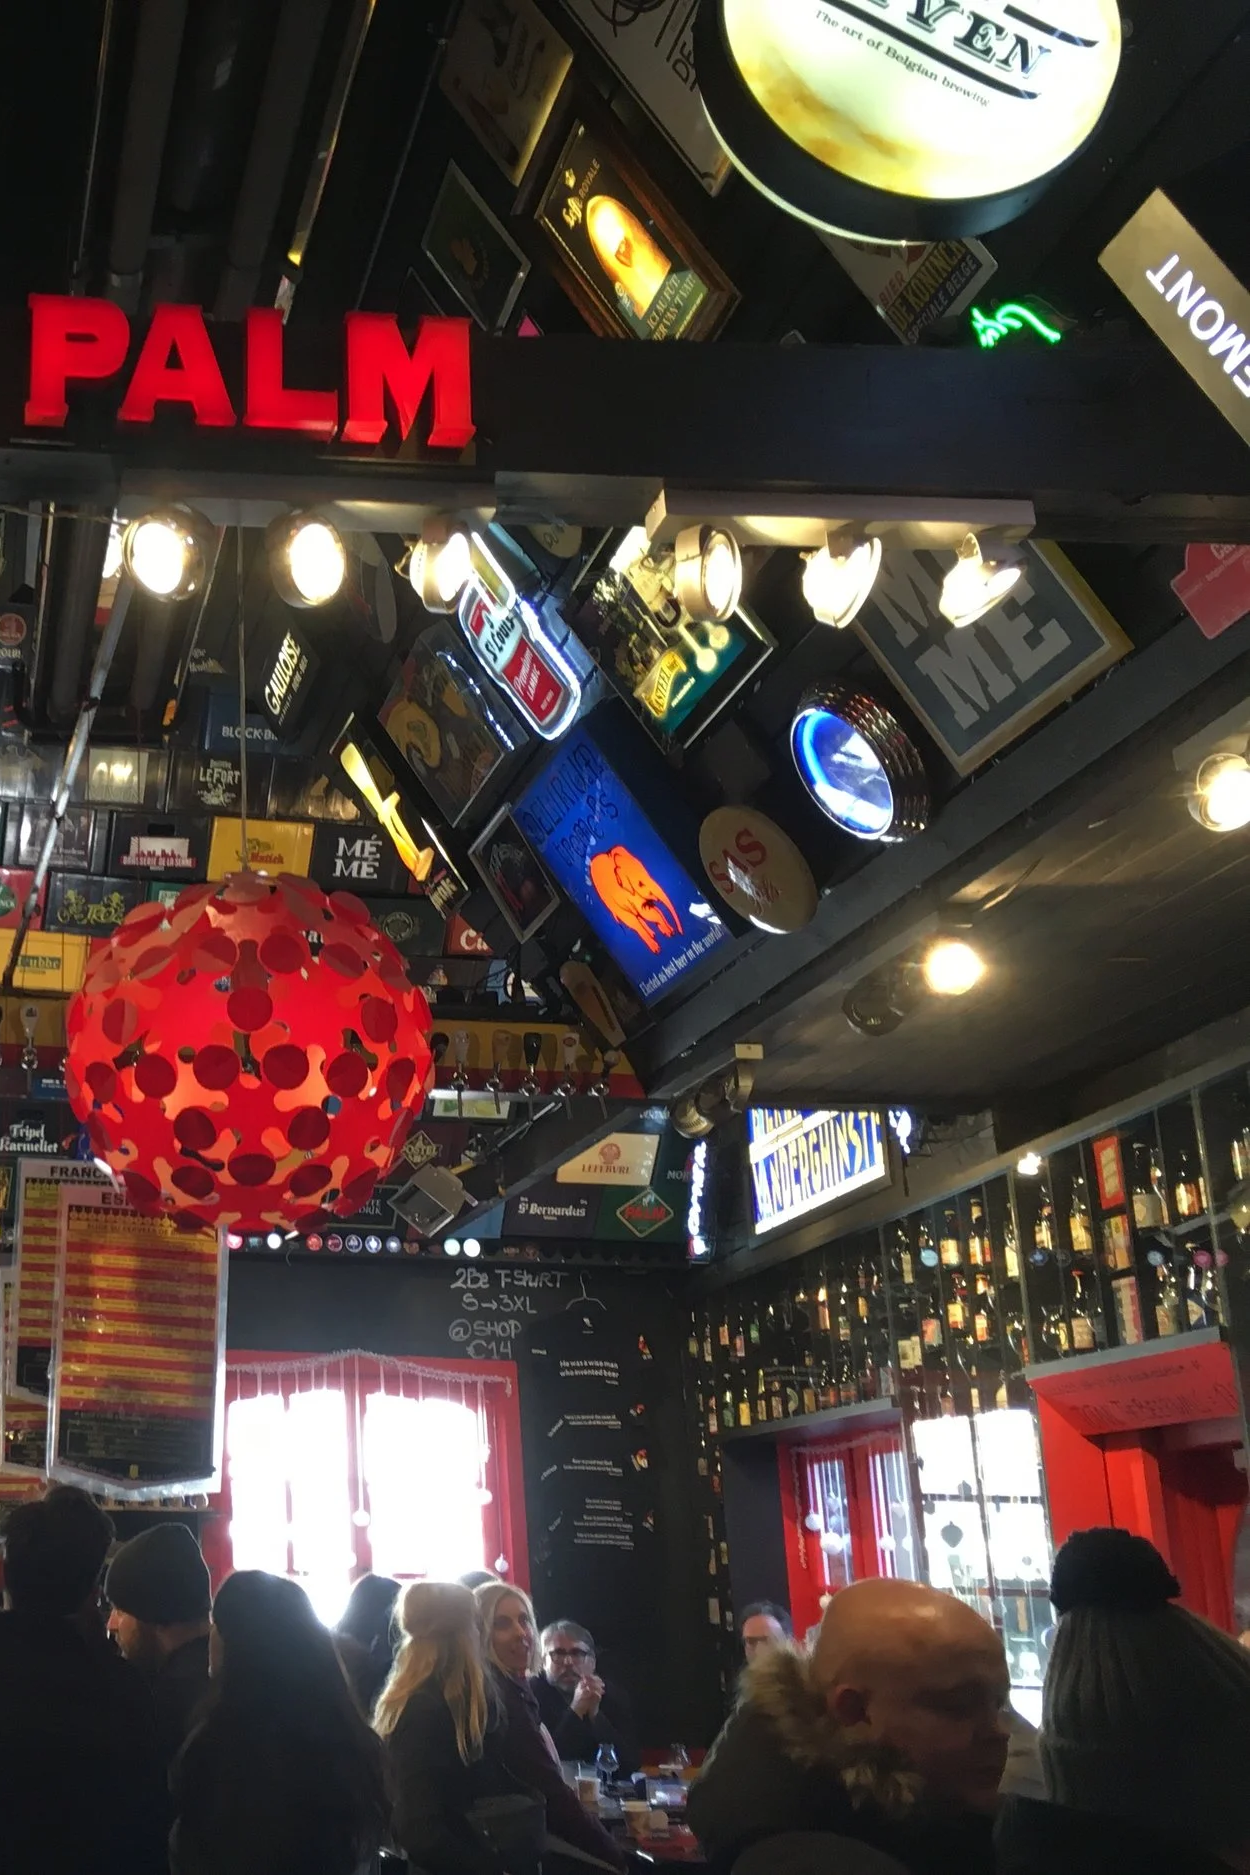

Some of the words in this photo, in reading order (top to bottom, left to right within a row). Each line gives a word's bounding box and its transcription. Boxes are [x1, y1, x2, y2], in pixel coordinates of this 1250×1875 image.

[815, 9, 839, 28] The
[842, 24, 863, 41] art
[866, 37, 883, 50] of
[885, 45, 938, 81] Belgian
[878, 270, 906, 306] BIER
[906, 290, 949, 344] SPECIALE
[945, 253, 979, 297] BELGE
[23, 293, 475, 448] PALM
[264, 629, 301, 716] GAULOISE
[639, 972, 661, 997] Elected
[9, 1121, 46, 1140] Tripel
[529, 1203, 587, 1217] Bernardus
[625, 1205, 666, 1220] PALM
[500, 1294, 537, 1314] 3XL
